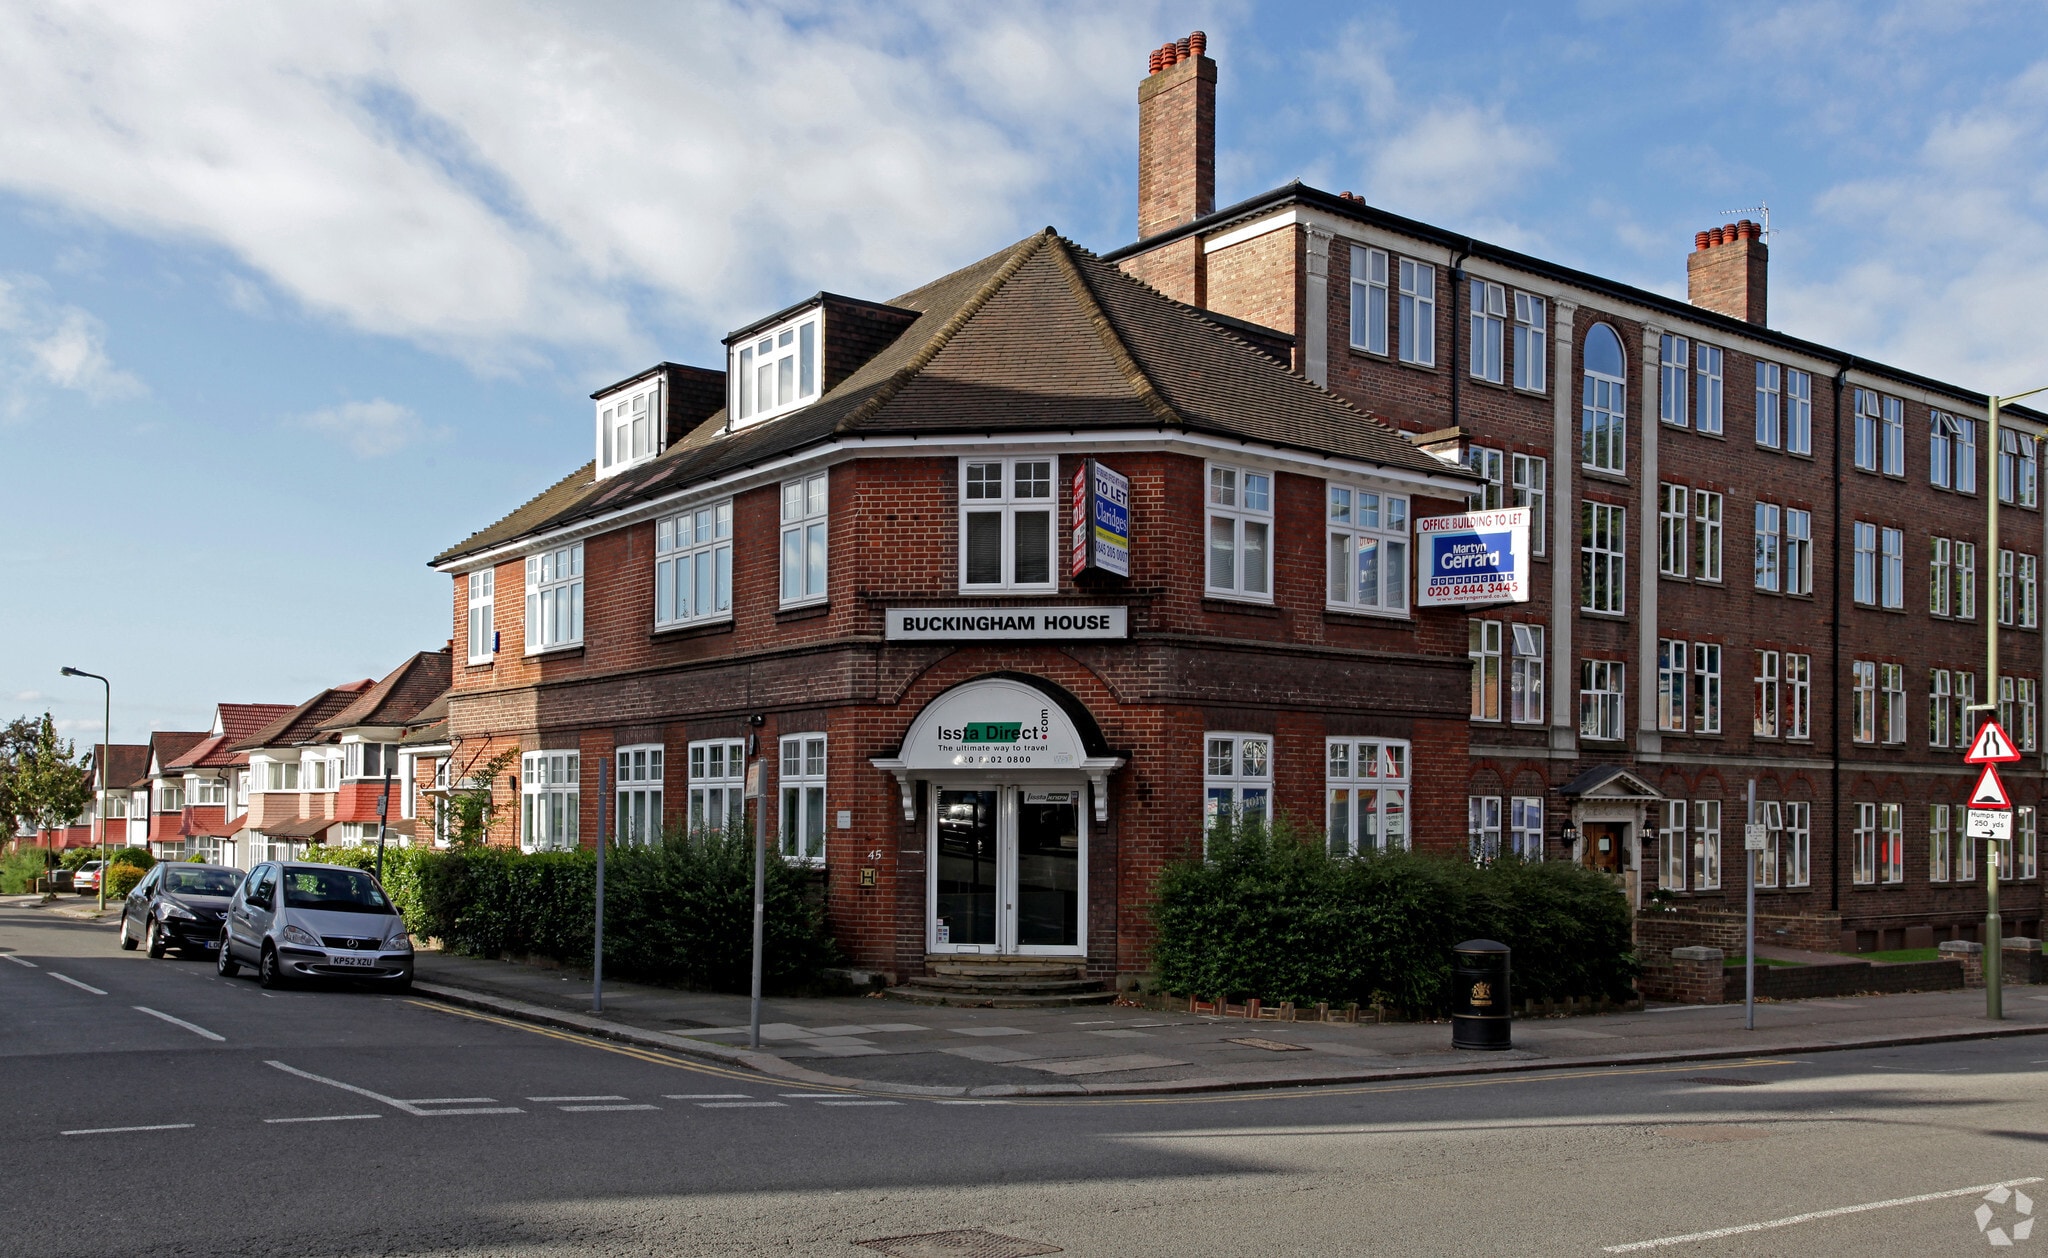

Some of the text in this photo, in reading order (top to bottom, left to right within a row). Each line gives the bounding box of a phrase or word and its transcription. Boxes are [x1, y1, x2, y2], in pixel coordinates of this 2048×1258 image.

[1095, 477, 1108, 495] TO
[1111, 486, 1127, 505] LET
[1095, 500, 1127, 533] Claridges
[1422, 513, 1522, 531] OFFICE BUILDING TO LET
[1453, 543, 1487, 554] Martyn
[1441, 551, 1500, 569] Gerrard
[1431, 574, 1514, 586] COMMERCIAL
[1428, 582, 1518, 597] 020 8444 3445
[1436, 593, 1509, 602] www.martyngerrard.co.uk
[903, 615, 1110, 631] BUCKINGHAM HOUSE
[938, 726, 979, 740] Issta
[986, 726, 1038, 740] Direct
[1006, 756, 1031, 764] 0800
[867, 849, 882, 860] 45
[333, 956, 372, 966] KP52 XZU
